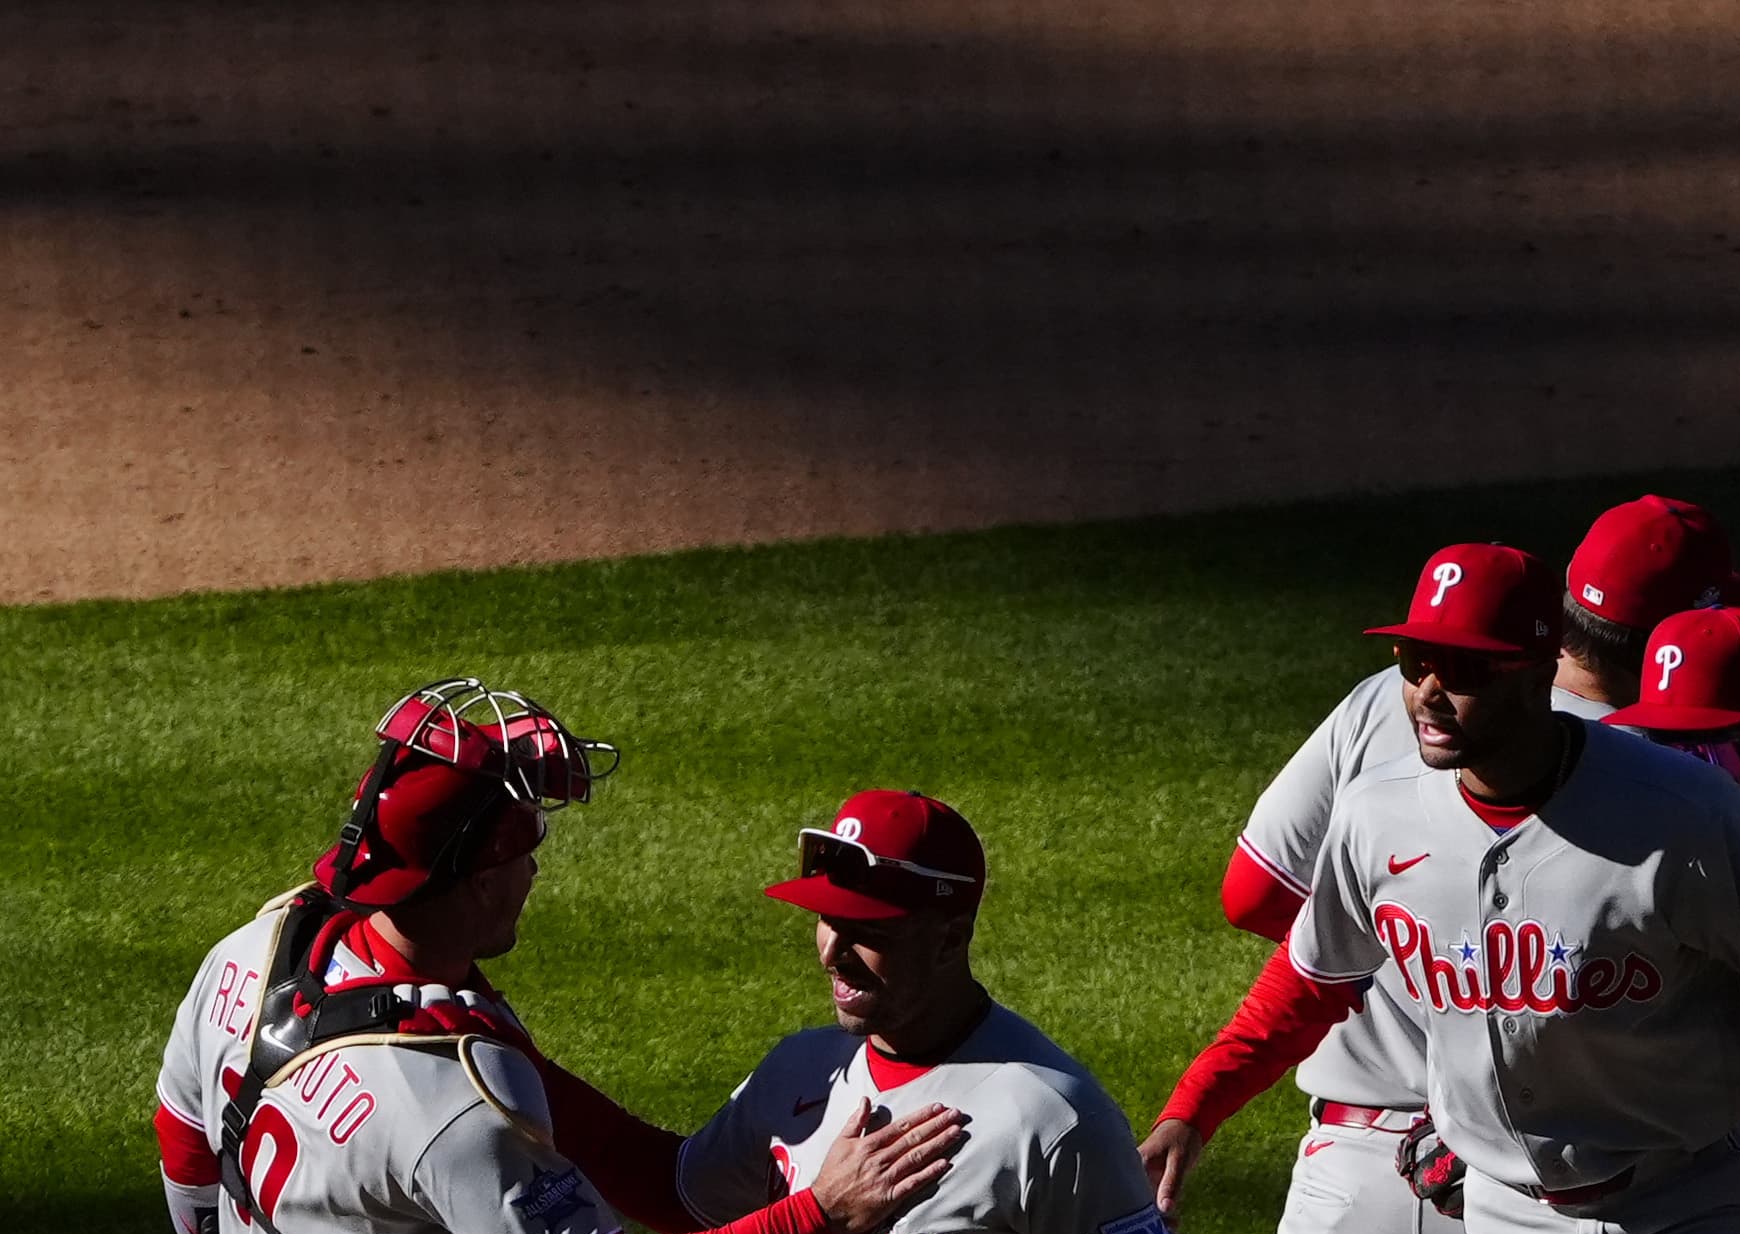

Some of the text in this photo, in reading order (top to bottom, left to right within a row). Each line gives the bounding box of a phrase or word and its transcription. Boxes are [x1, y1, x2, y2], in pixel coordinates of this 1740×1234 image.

[1430, 562, 1464, 608] P
[1655, 644, 1684, 692] P
[1372, 900, 1664, 1014] Phillies
